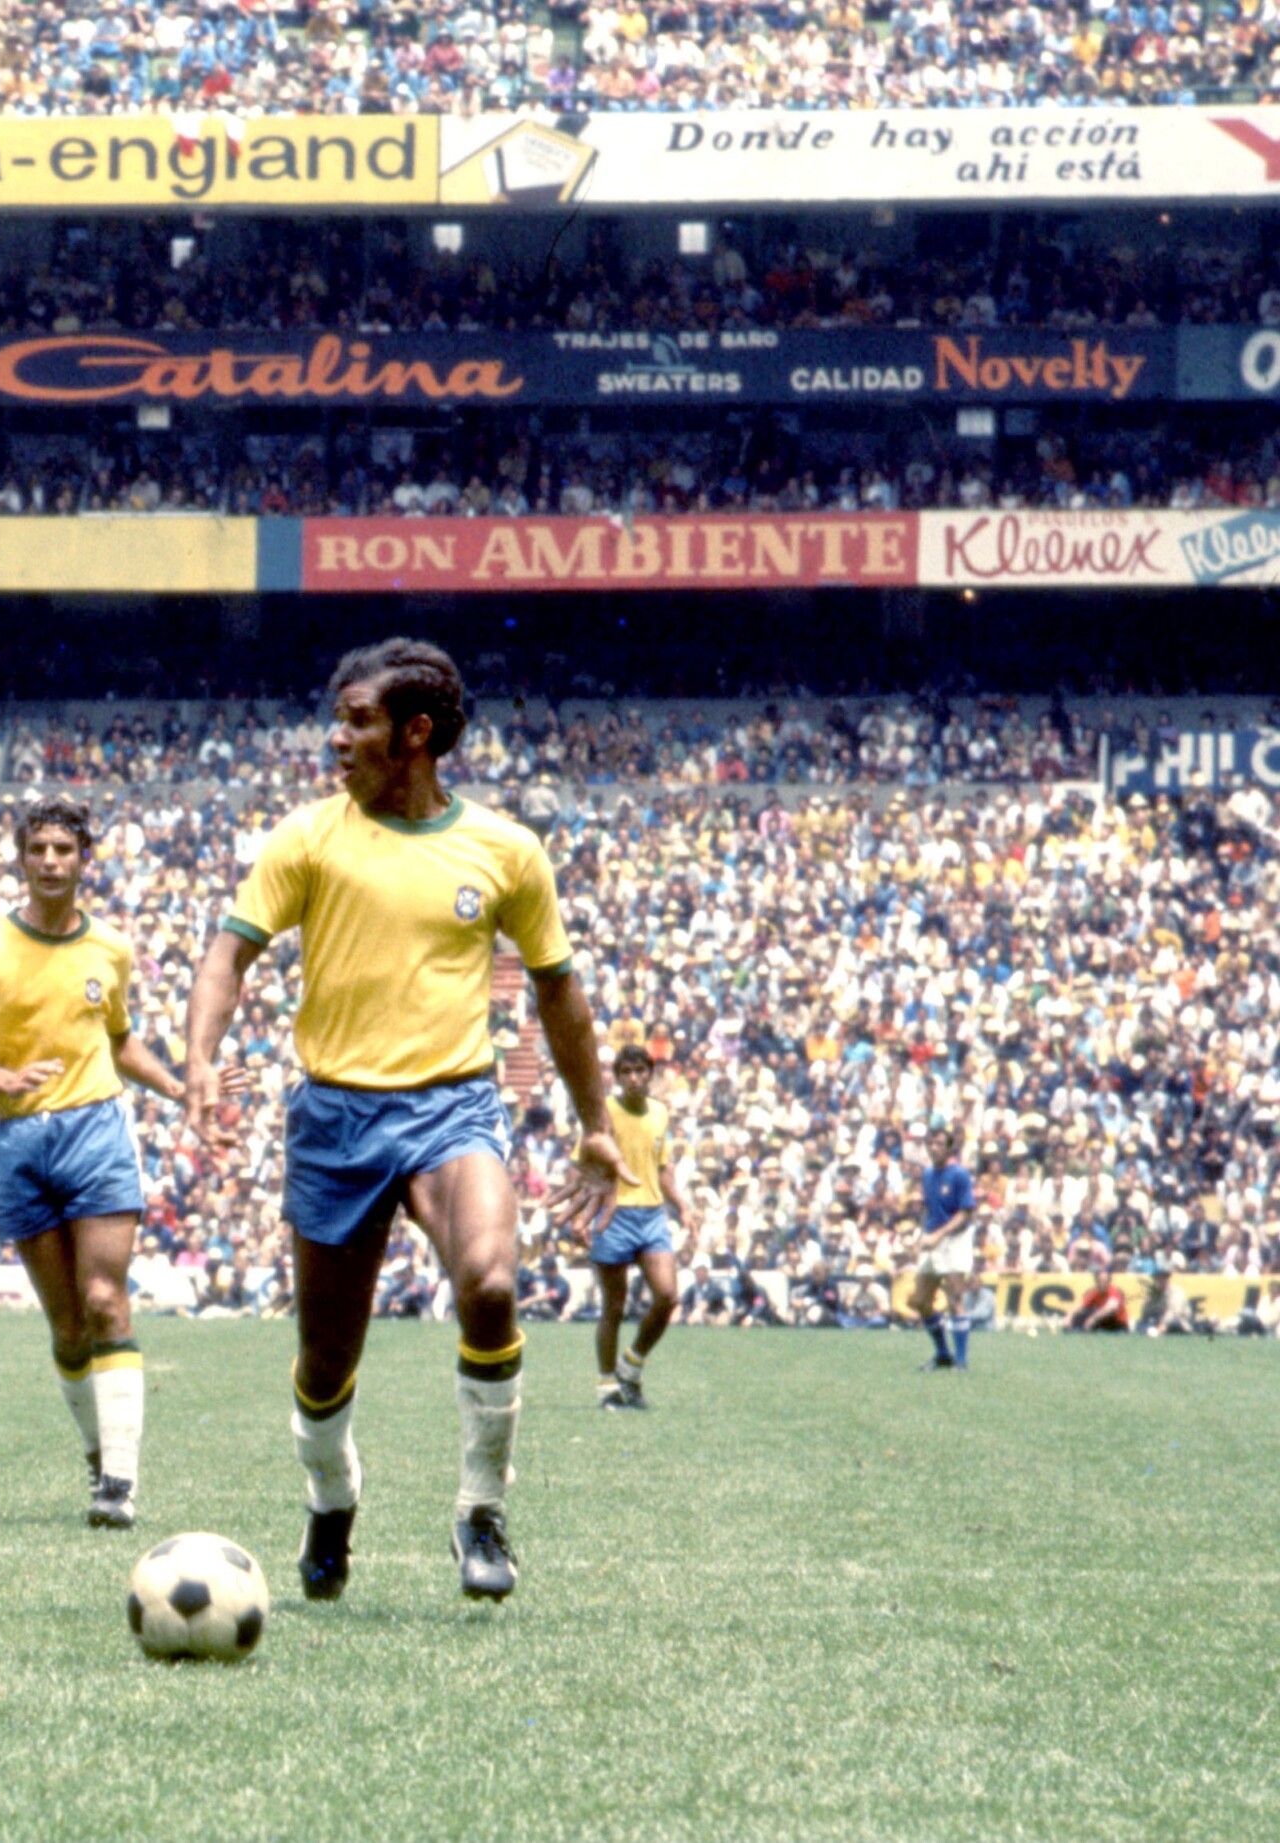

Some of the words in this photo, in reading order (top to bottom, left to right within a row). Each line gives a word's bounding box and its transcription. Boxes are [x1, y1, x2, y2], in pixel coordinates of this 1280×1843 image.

[666, 121, 835, 152] Donde
[871, 119, 954, 156] hay
[991, 117, 1139, 147] acción
[1055, 150, 1142, 182] está
[554, 332, 651, 349] TRAJES
[678, 332, 709, 348] DE
[597, 373, 742, 393] SWEATERS
[790, 368, 923, 391] CALIDAD
[932, 334, 1146, 398] Novelty
[316, 534, 458, 570] RON
[471, 520, 907, 580] AMBIENTE
[944, 513, 1168, 578] Kleenex
